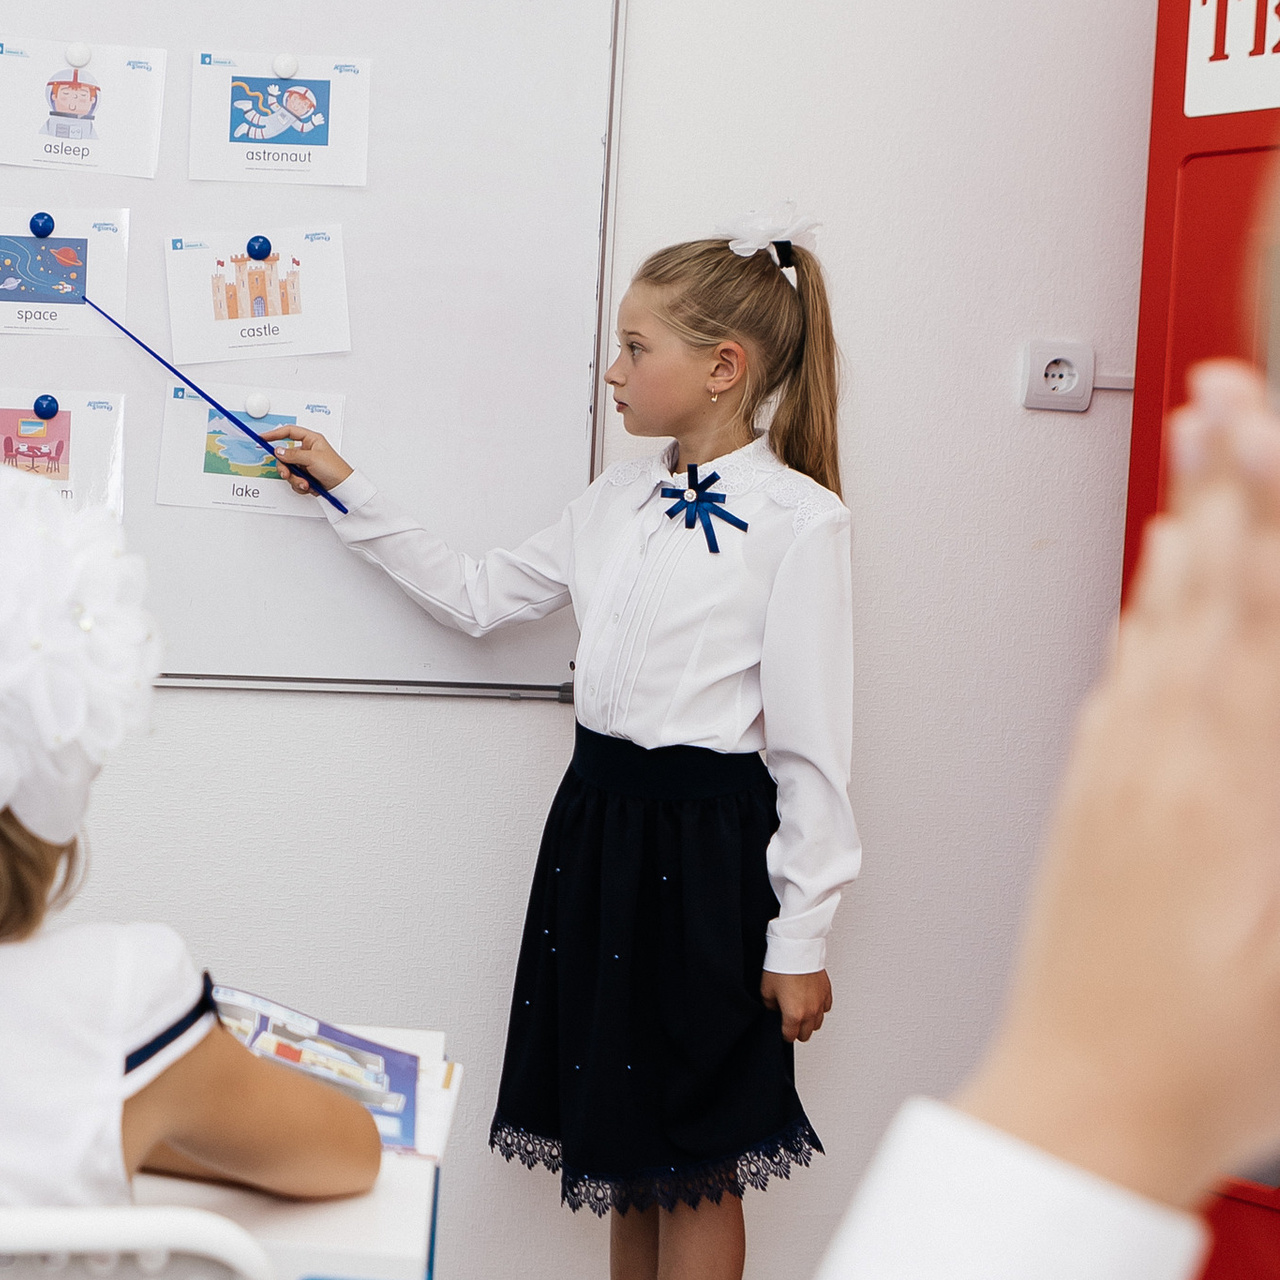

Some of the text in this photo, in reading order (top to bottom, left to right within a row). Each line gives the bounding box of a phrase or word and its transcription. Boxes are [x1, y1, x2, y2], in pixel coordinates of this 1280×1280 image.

[43, 141, 90, 160] asleep
[245, 148, 312, 163] astronaut
[16, 309, 58, 324] space
[239, 322, 280, 339] castle
[231, 483, 261, 499] lake
